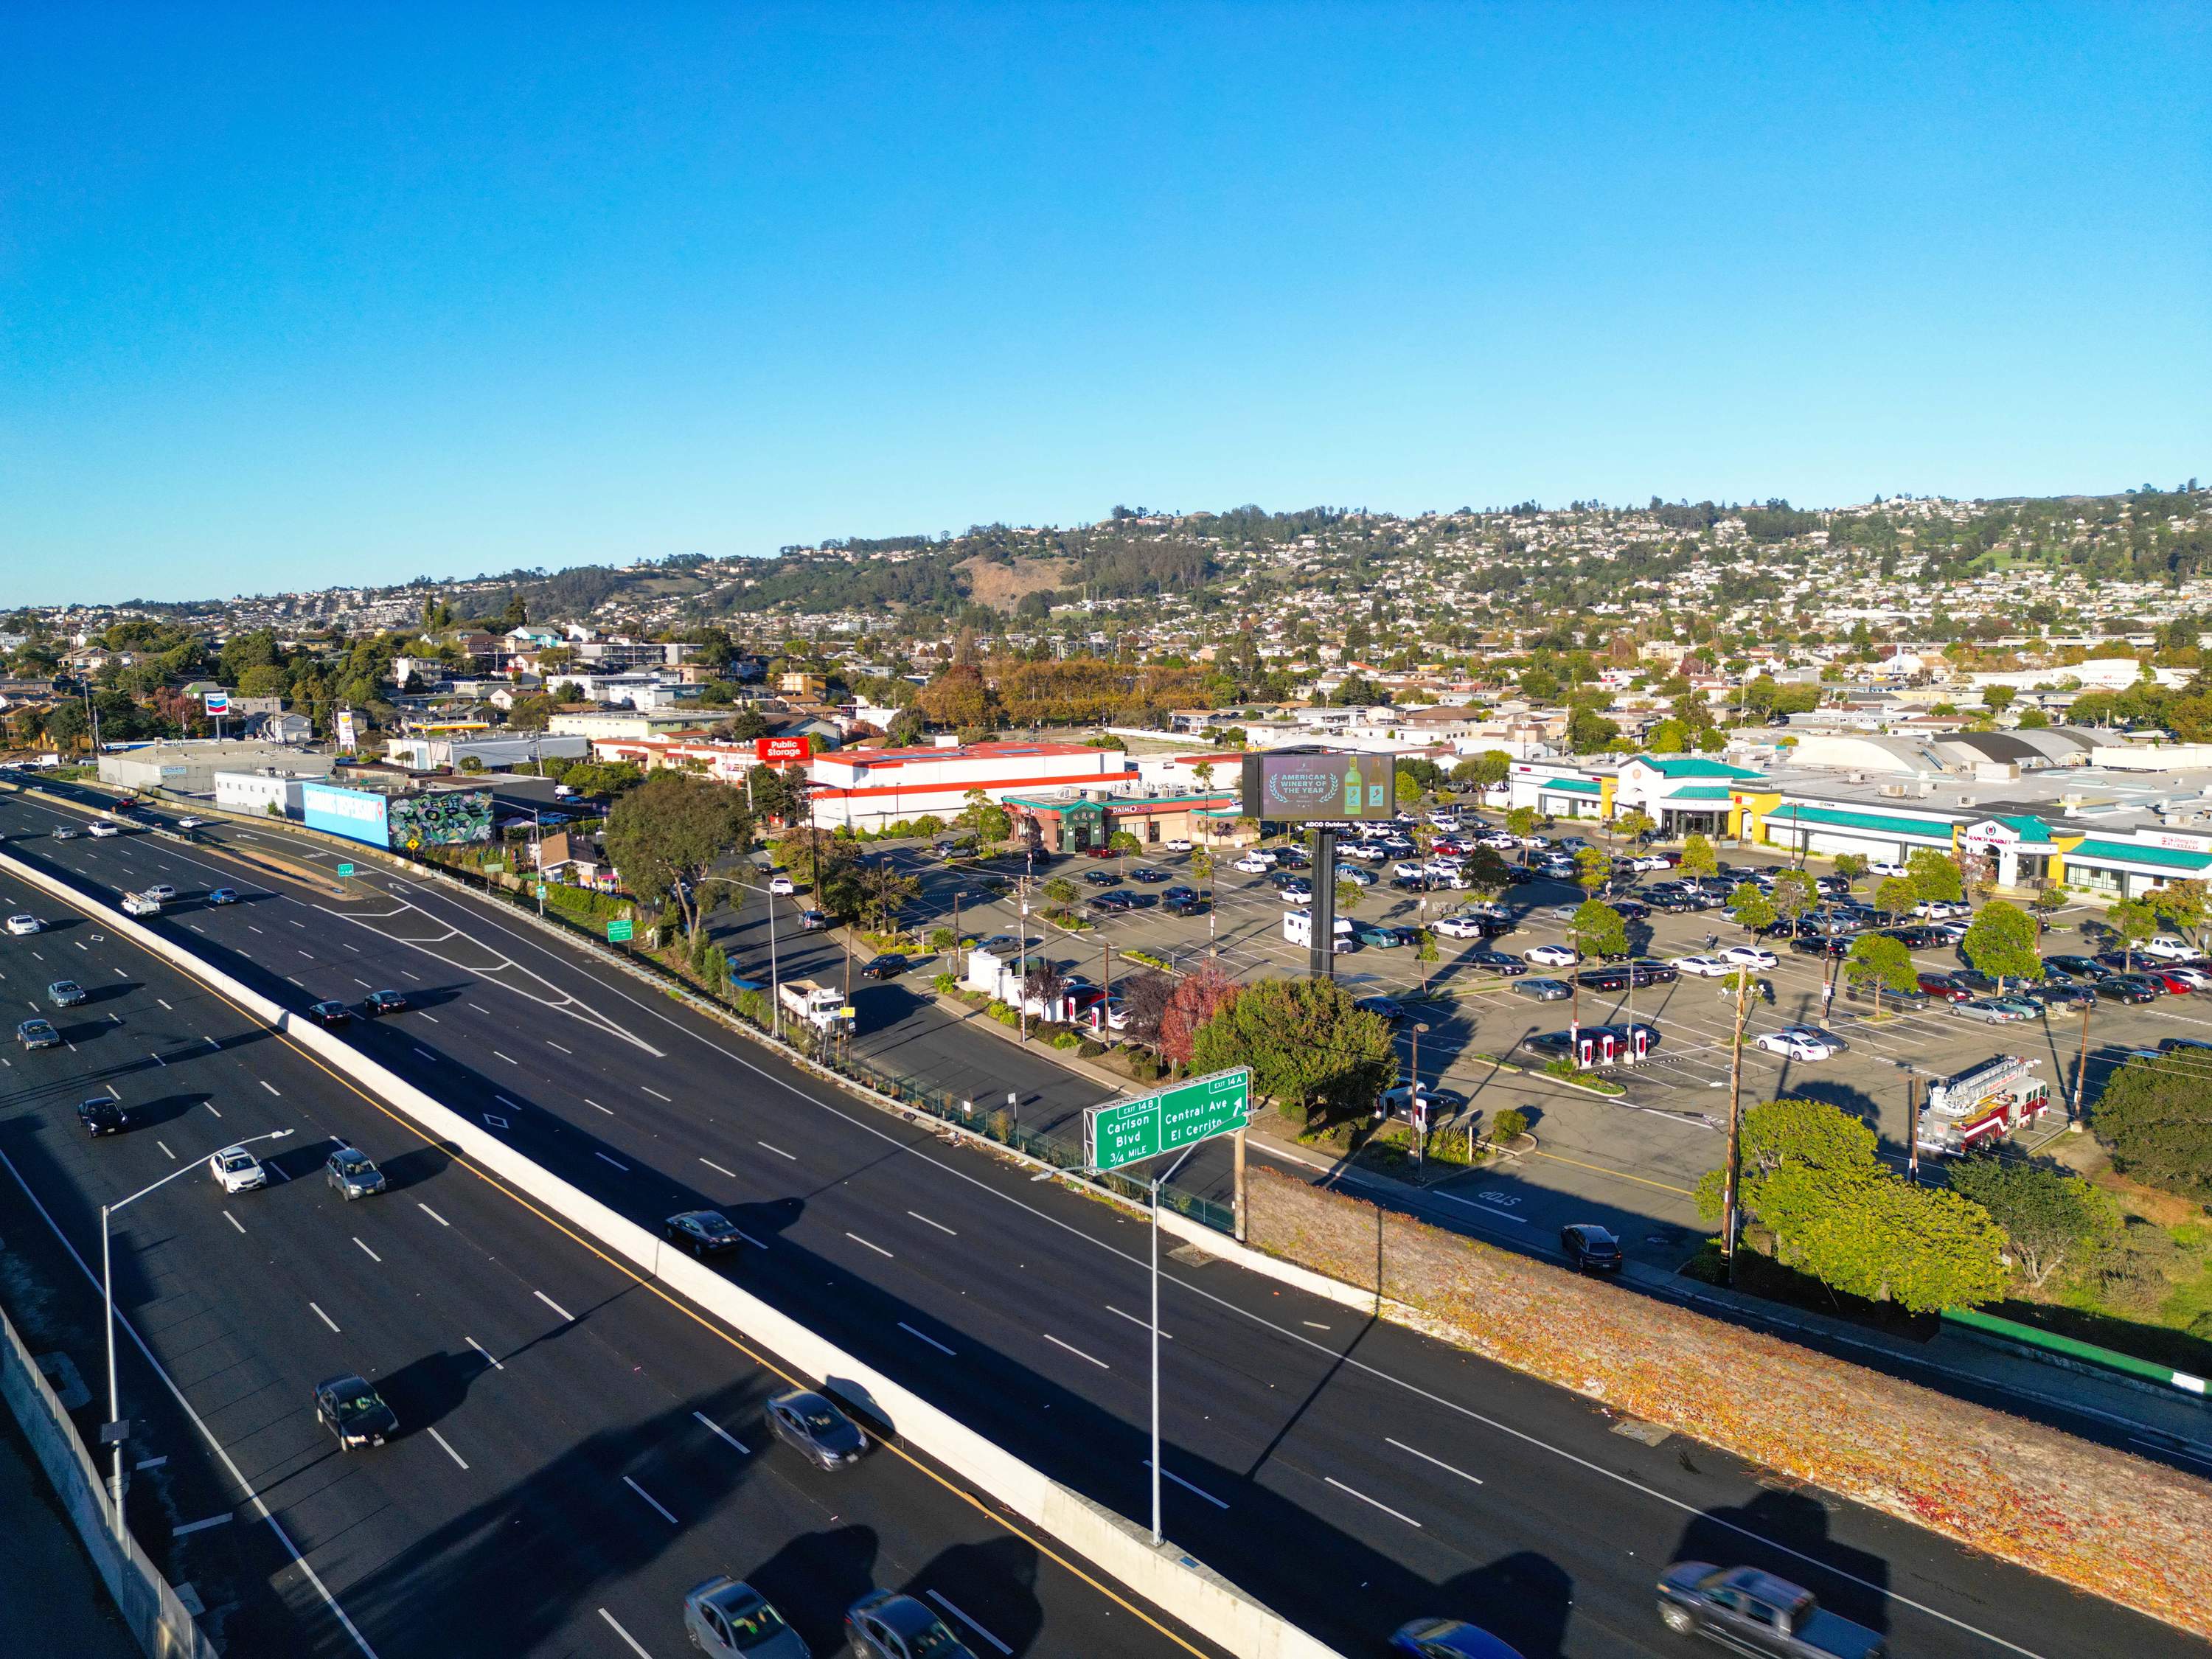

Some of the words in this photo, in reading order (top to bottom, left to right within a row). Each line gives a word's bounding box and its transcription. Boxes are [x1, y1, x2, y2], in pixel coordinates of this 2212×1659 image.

[768, 748, 801, 757] Storage
[1113, 805, 1137, 813] DAIMO
[1124, 1106, 1135, 1114] EXIT
[1166, 1105, 1203, 1124] Central
[1209, 1100, 1227, 1112] Ave
[1107, 1116, 1149, 1135] Carlson
[1171, 1129, 1180, 1141] El
[1186, 1119, 1222, 1135] Cerrito
[1116, 1130, 1140, 1147] Blvd
[1110, 1151, 1124, 1165] 3/4
[1128, 1145, 1147, 1158] MILE
[1478, 1192, 1522, 1206] STOP
